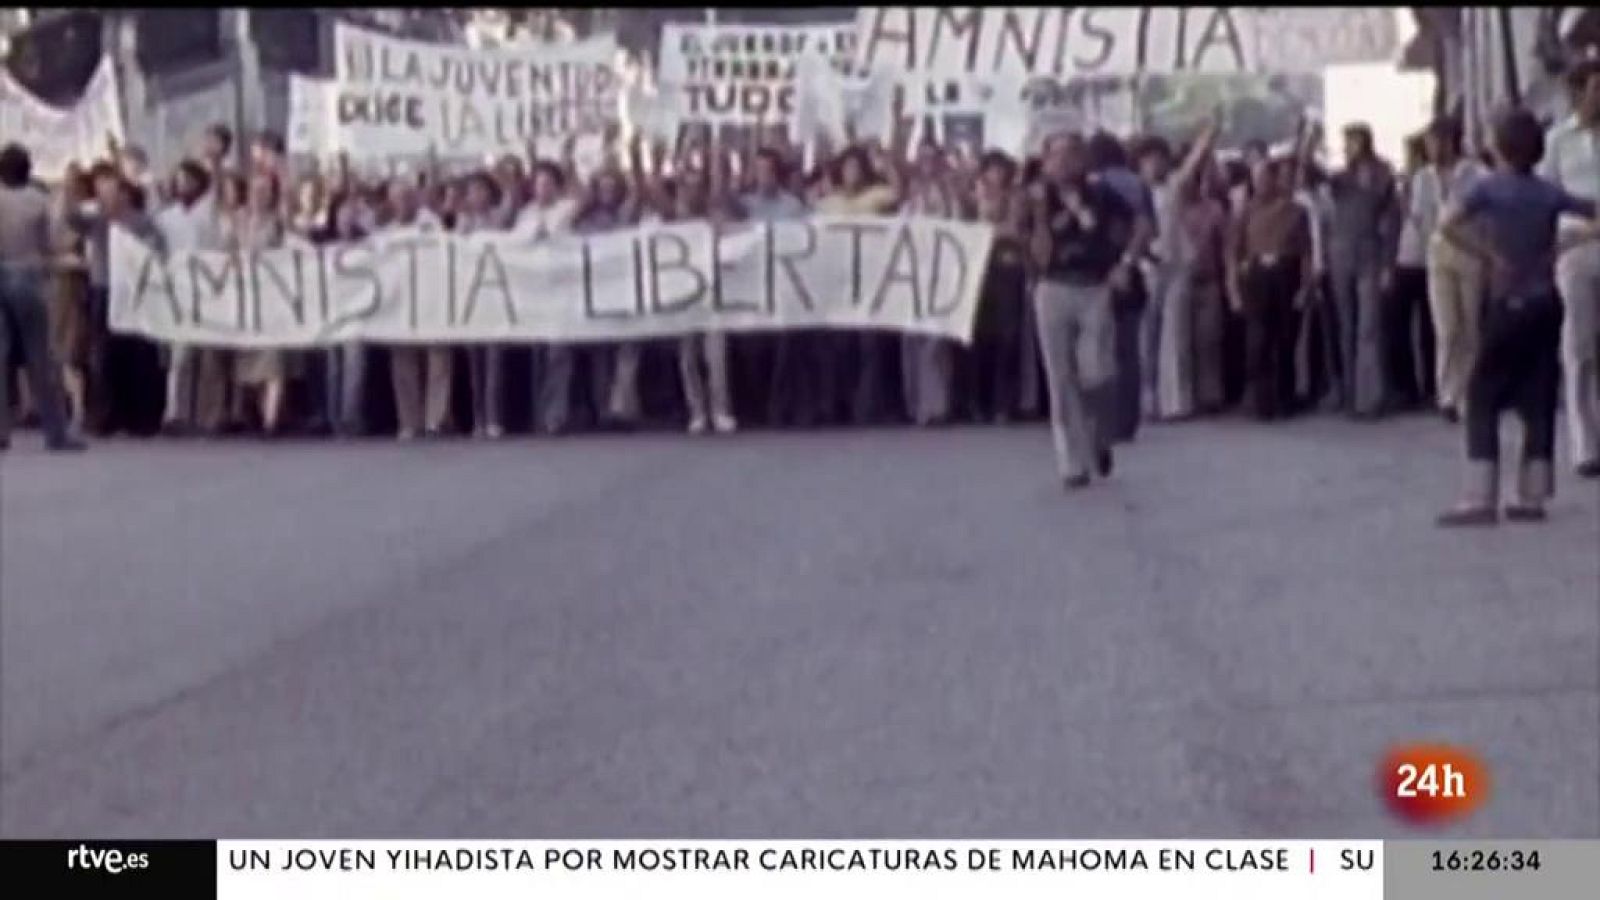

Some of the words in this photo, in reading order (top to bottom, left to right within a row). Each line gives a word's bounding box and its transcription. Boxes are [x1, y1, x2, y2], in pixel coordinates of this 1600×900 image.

[857, 8, 1245, 79] AMNISTIA
[133, 240, 519, 343] AMNISTIA
[582, 223, 968, 319] LIBERTAD
